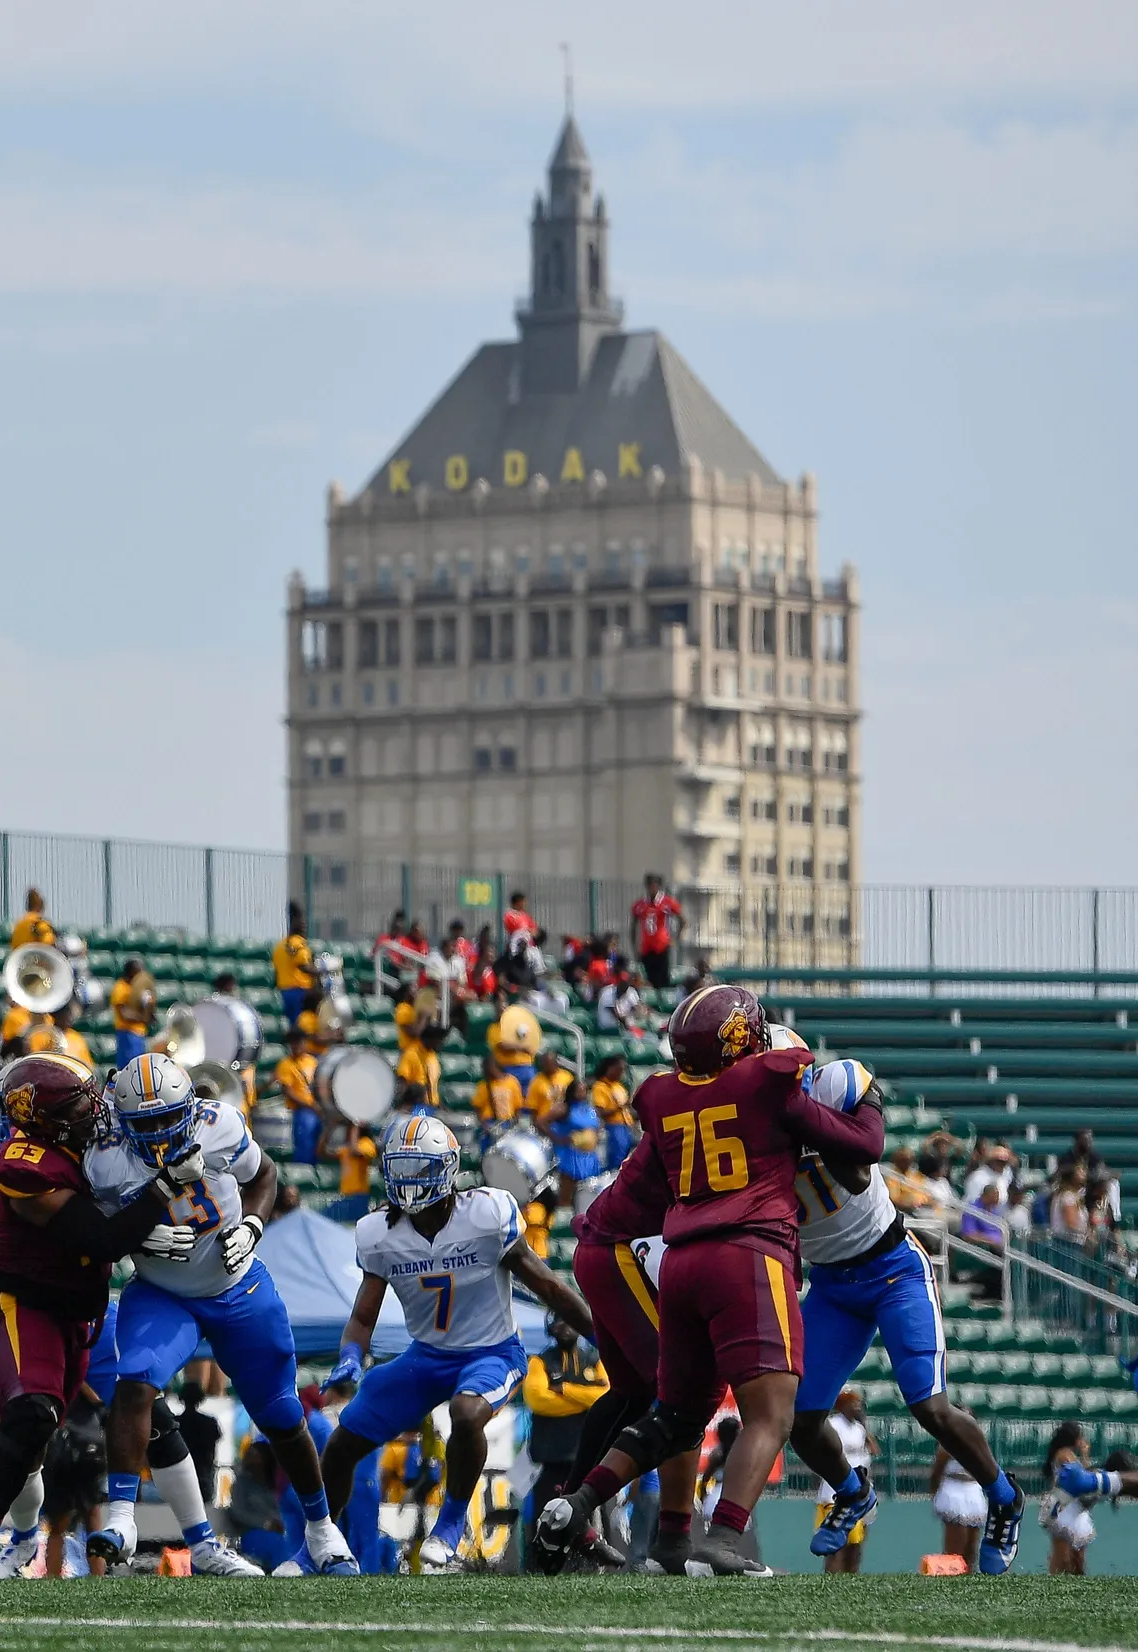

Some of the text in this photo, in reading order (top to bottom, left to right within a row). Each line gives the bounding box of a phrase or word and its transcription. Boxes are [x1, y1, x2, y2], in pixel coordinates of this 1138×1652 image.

[389, 443, 643, 494] KODAK
[3, 1142, 46, 1164] 63
[662, 1103, 749, 1197] 76
[391, 1252, 479, 1277] ALBANY STATE
[418, 1271, 455, 1333] 7
